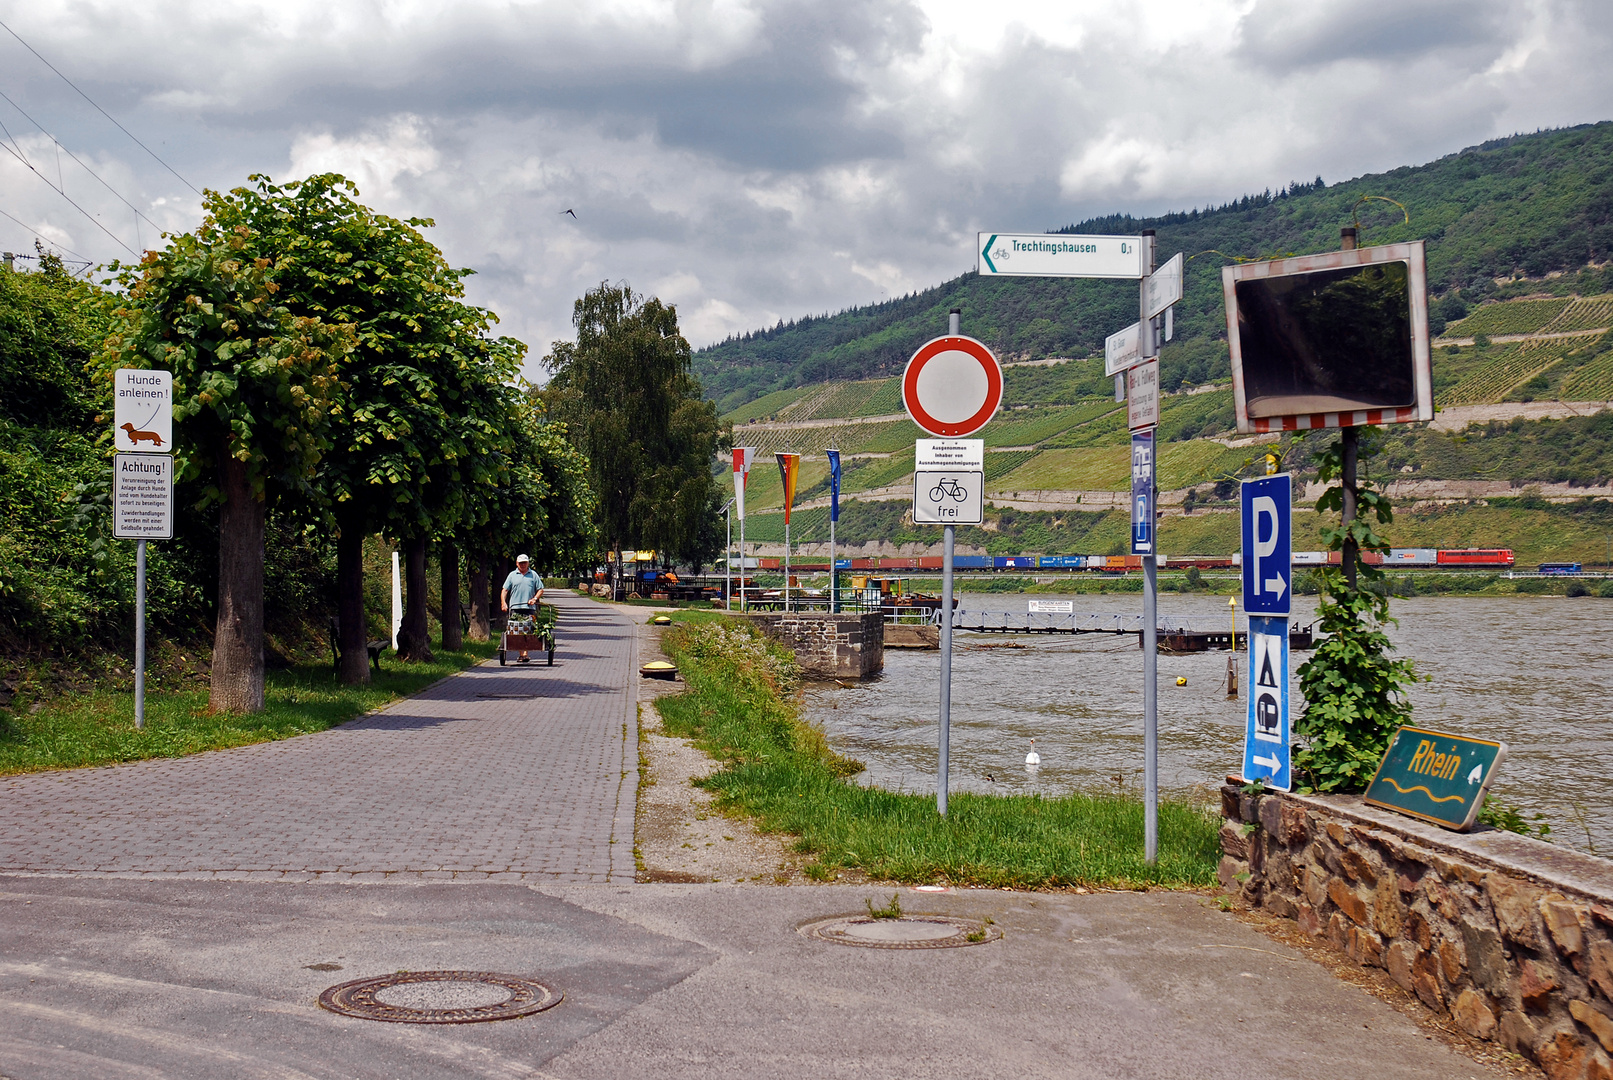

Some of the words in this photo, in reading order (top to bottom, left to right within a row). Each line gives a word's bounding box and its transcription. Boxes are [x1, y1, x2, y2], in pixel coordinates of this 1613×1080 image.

[1012, 239, 1097, 255] Trechtingshausen
[127, 374, 161, 385] Hunde
[122, 477, 156, 485] Verunreinigung
[938, 506, 959, 517] frei
[1137, 500, 1145, 537] P
[1252, 496, 1279, 595] P
[1408, 739, 1461, 781] Rhein
